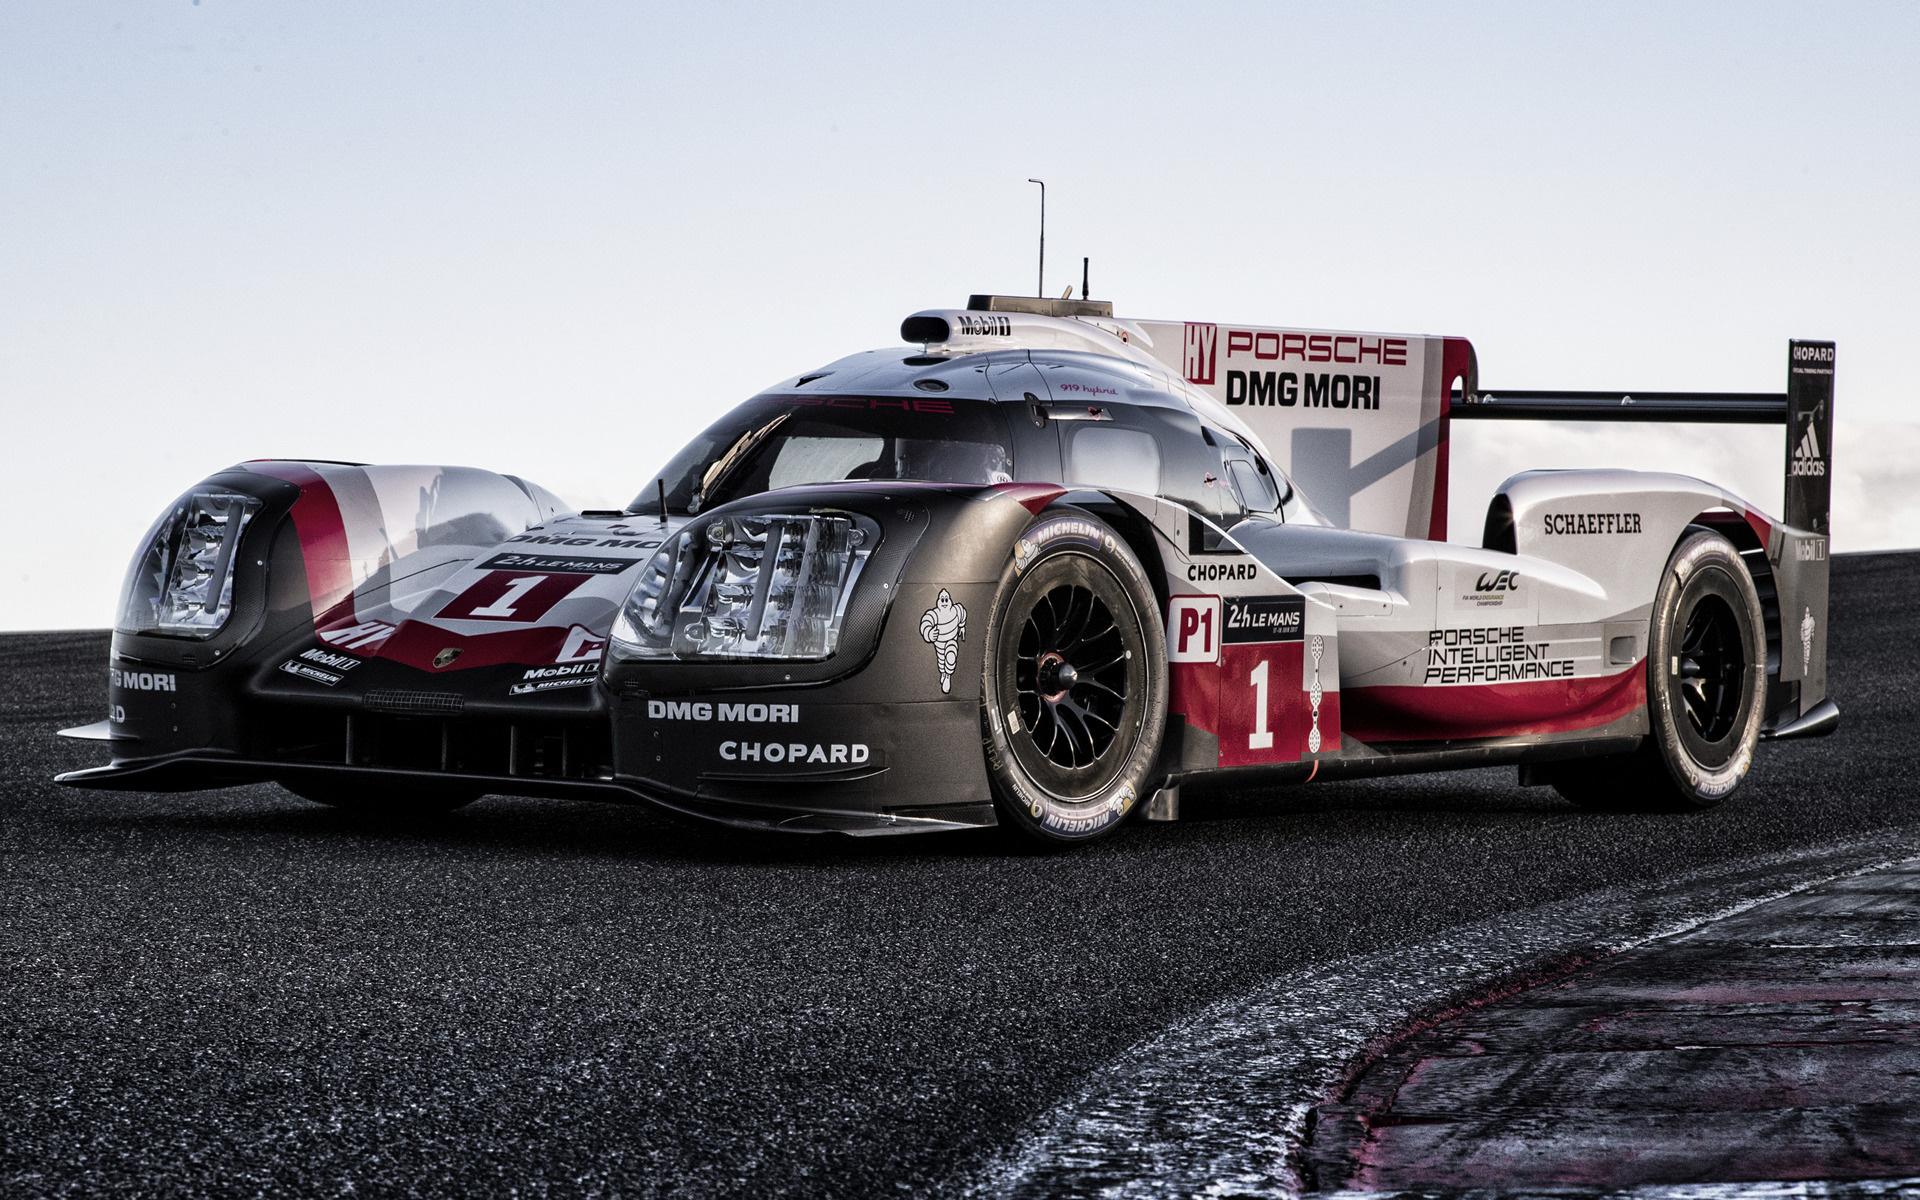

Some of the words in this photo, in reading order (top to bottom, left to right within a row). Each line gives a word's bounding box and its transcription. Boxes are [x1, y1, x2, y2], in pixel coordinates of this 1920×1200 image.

[958, 316, 998, 336] Mobil
[999, 316, 1011, 336] 1
[1184, 323, 1217, 381] HY
[1227, 331, 1408, 366] PORSCHE
[1793, 346, 1834, 361] CHOPARD
[1082, 385, 1119, 397] hybrid
[1226, 370, 1298, 407] DMG
[1303, 373, 1381, 410] MORI
[1792, 457, 1825, 476] adidas
[1038, 522, 1100, 543] MICHELIN
[1544, 513, 1642, 535] SCHAEFFLER
[504, 535, 597, 546] DMG
[596, 539, 663, 549] MO
[1816, 540, 1825, 560] 1
[537, 560, 565, 568] LE
[564, 561, 624, 571] MANS
[1187, 564, 1257, 581] CHOPARD
[1476, 570, 1519, 592] WEC
[469, 575, 549, 617] 1
[1228, 604, 1251, 628] 24h
[1252, 613, 1266, 627] LE
[1267, 611, 1300, 627] MANS
[1178, 608, 1212, 653] P1
[1429, 626, 1524, 646] PORSCHE
[299, 648, 346, 667] Mobil
[1428, 643, 1550, 665] INTELLIGENT
[123, 671, 176, 691] MORI
[298, 667, 340, 682] MICHELIN
[523, 664, 585, 679] Mobil
[1424, 660, 1574, 684] PERFORMANCE
[537, 676, 597, 689] MICHELIN
[648, 700, 713, 721] DMG
[717, 703, 799, 723] MORI
[1249, 660, 1273, 749] 1
[719, 741, 869, 763] CHOPARD
[1046, 811, 1110, 832] MICHELIN
